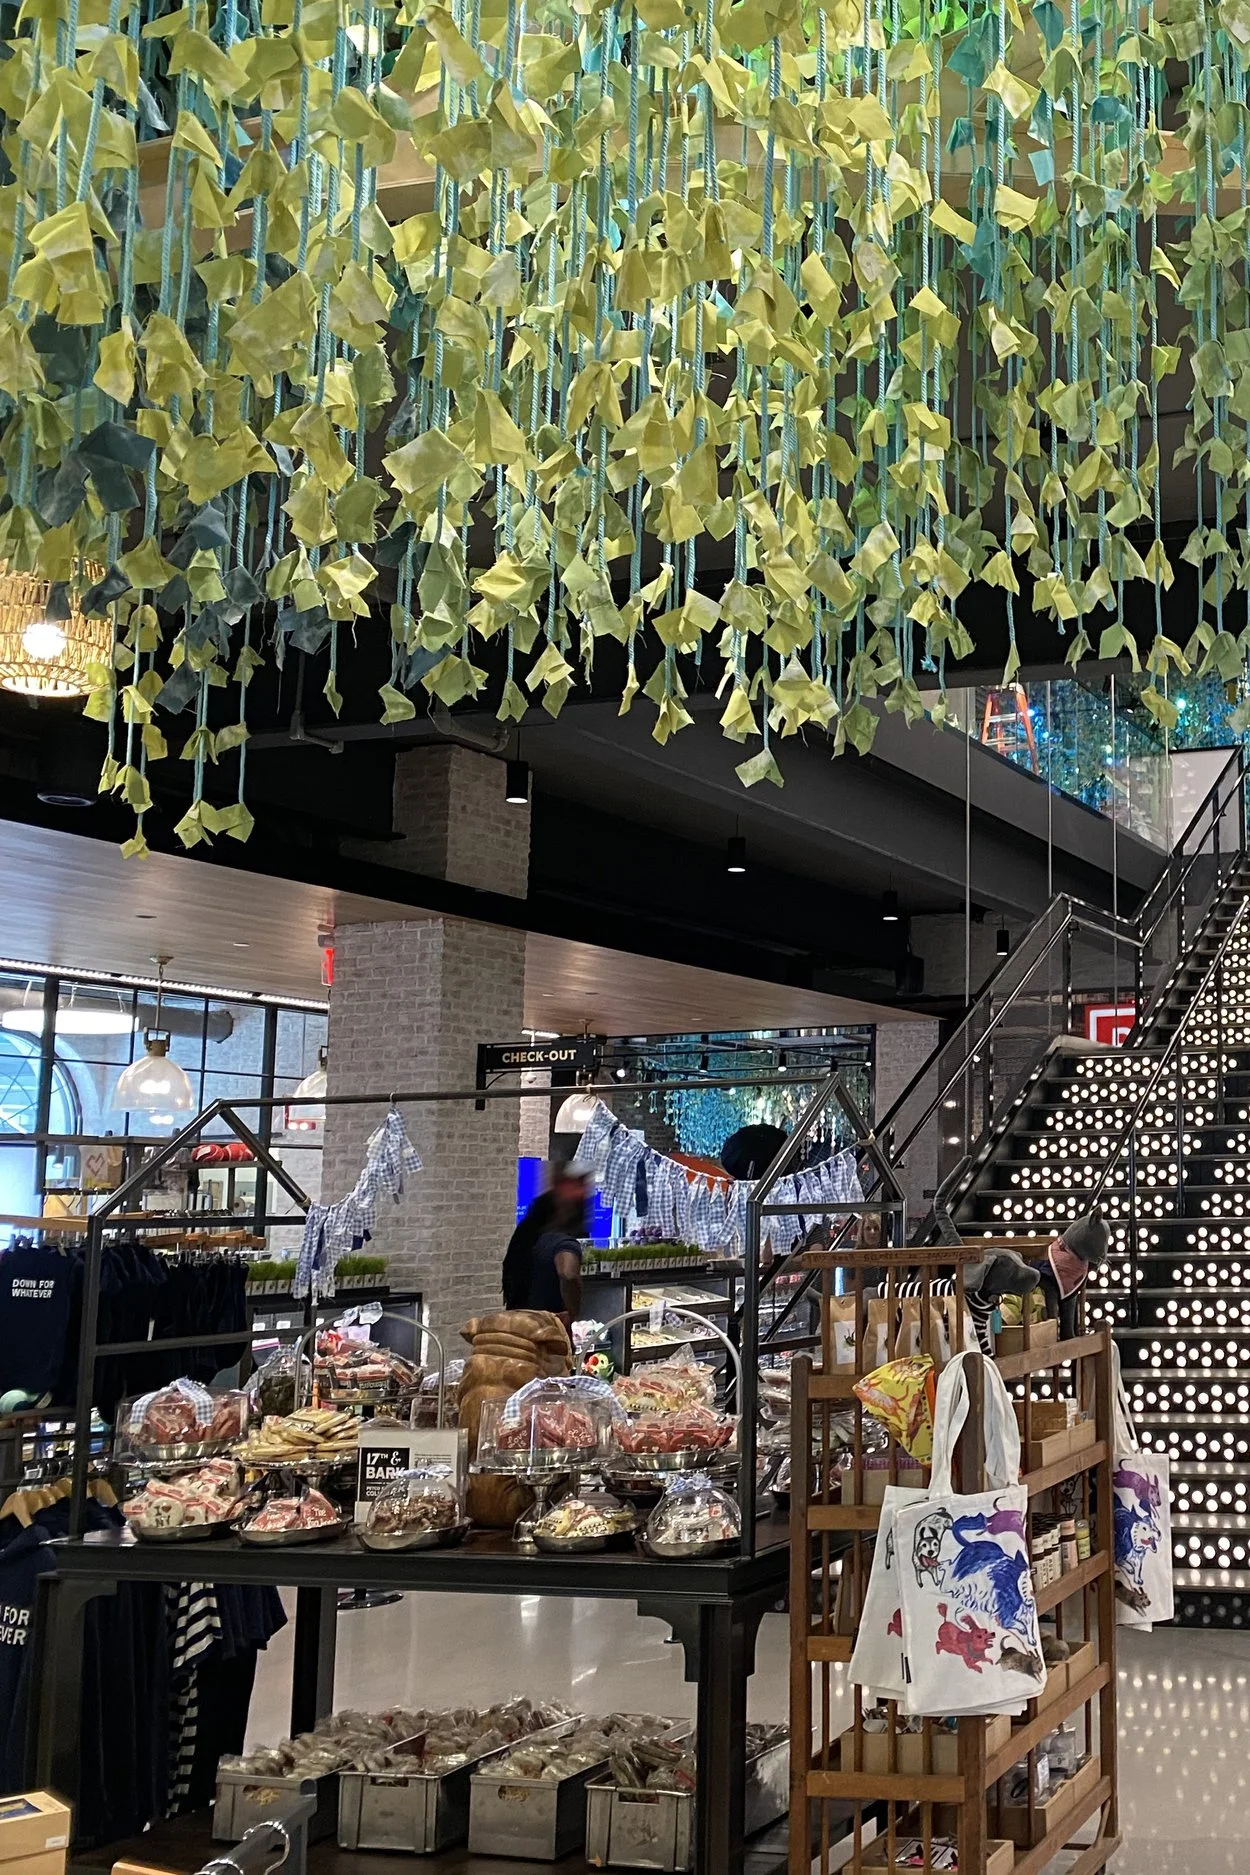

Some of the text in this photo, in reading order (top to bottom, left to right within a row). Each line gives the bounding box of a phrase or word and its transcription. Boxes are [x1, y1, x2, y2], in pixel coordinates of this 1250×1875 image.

[502, 1049, 577, 1063] CHECK-OUT
[12, 1279, 55, 1288] DOWN FOR
[12, 1288, 52, 1298] WHATEVER
[366, 1452, 389, 1466] 17TH
[390, 1451, 402, 1466] &
[3, 1606, 30, 1626] FOR
